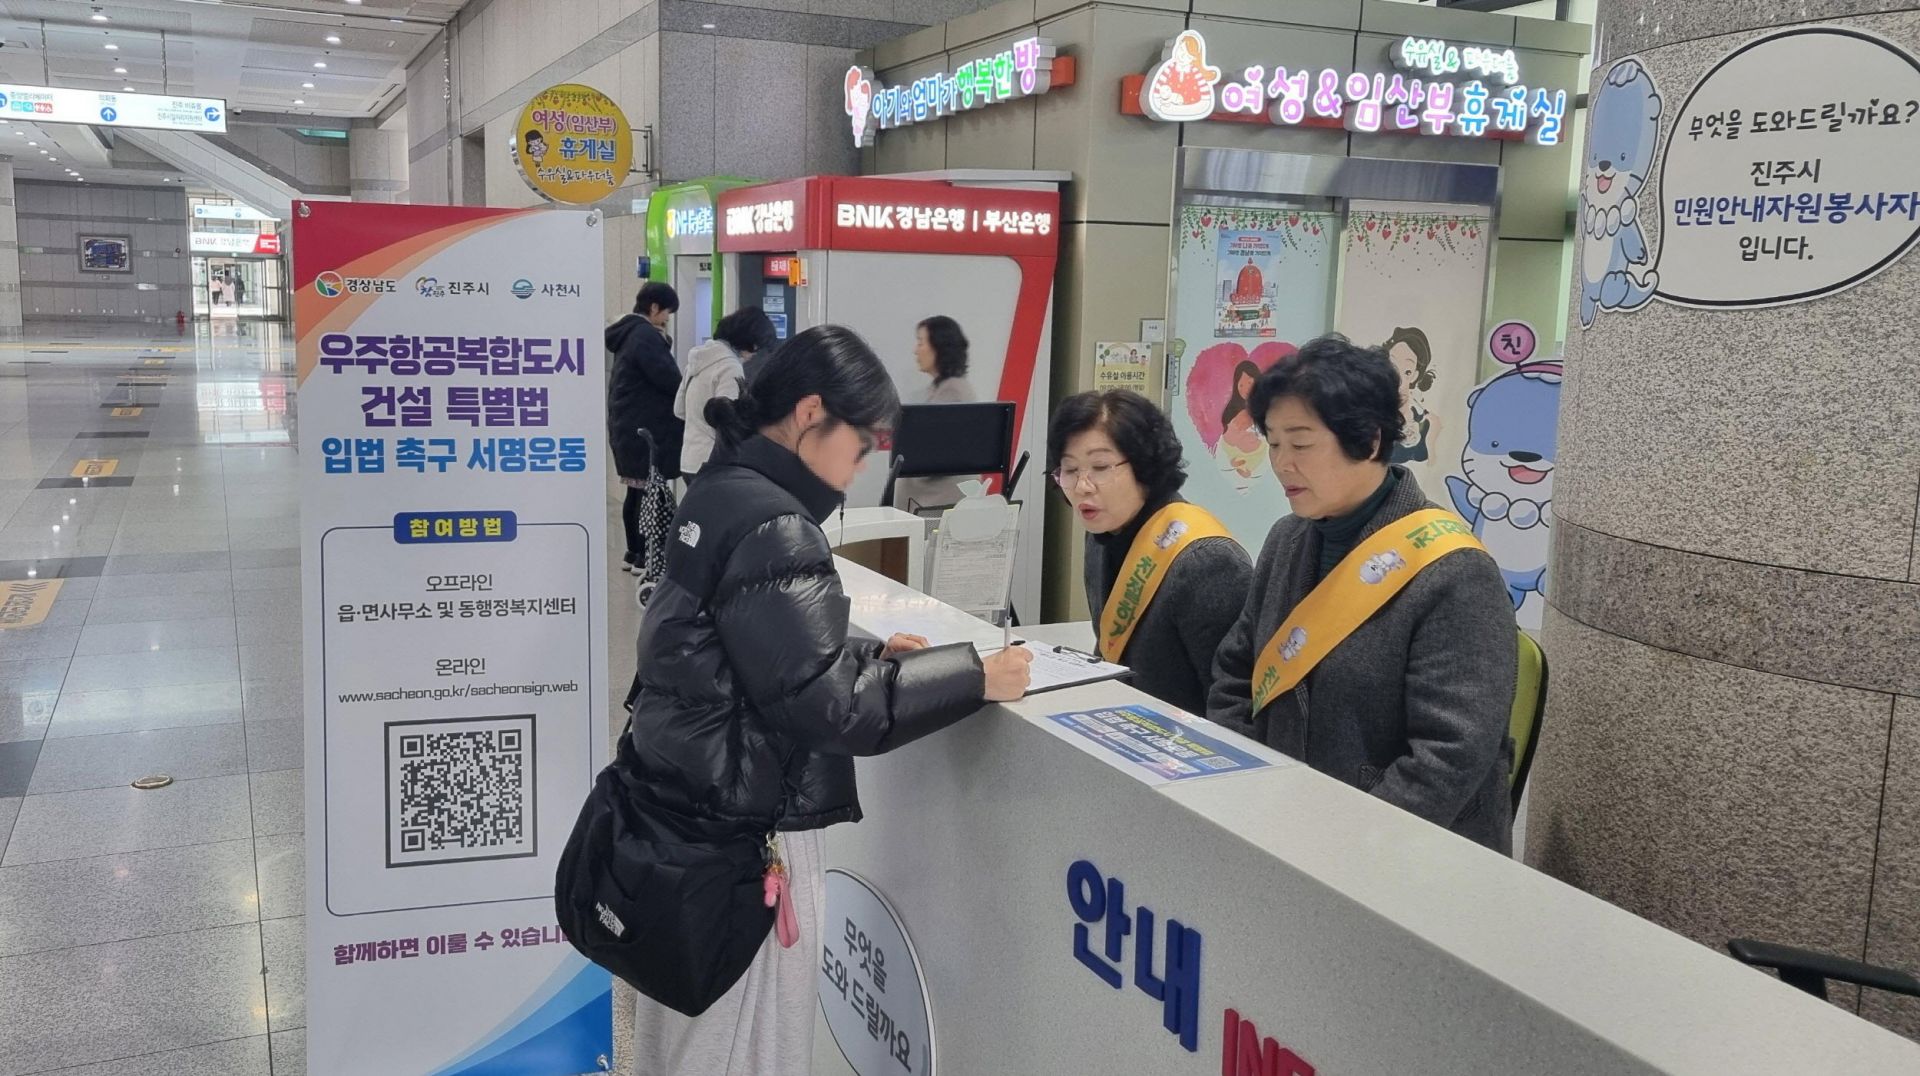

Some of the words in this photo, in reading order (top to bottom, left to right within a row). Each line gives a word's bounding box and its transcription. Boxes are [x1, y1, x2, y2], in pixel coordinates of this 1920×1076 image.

[873, 88, 911, 127] 아기와
[957, 52, 1013, 108] 행복한
[1014, 36, 1040, 93] 방
[532, 109, 617, 134] 여성(임산부)
[1688, 109, 1742, 141] 무엇을
[1750, 100, 1920, 134] 도와드릴까요?
[559, 137, 616, 160] 휴게실
[1750, 159, 1821, 187] 진주시
[1674, 191, 1920, 226] 민원안내자원봉사자
[983, 208, 1051, 236] 부산은행
[1739, 236, 1814, 262] 입니다.
[347, 279, 397, 293] 경상남도
[448, 281, 489, 296] 진주시
[541, 283, 581, 297] 사천시
[320, 335, 585, 376] 우주항공복합도시
[1501, 334, 1521, 355] 친
[1100, 371, 1119, 381] 수유실
[361, 386, 432, 427] 건설
[447, 387, 549, 427] 특별법
[321, 437, 385, 473] 입법
[396, 437, 457, 473] 촉구
[467, 437, 587, 473] 서명운동
[410, 518, 502, 538] 참여방법
[426, 574, 493, 592] 오프라인
[337, 602, 433, 622] 읍·면사무소
[438, 602, 454, 618] 및
[458, 597, 576, 618] 동행정복지센터
[435, 658, 486, 676] 온라인
[338, 680, 578, 704] www.sacheon.go.kr/sacheonsign.web
[334, 937, 419, 965] 함께하면
[426, 933, 467, 955] 이룰
[474, 931, 494, 950] 수
[844, 917, 888, 994] 무엇을
[1067, 860, 1201, 1053] 안내
[822, 944, 849, 1001] 도와
